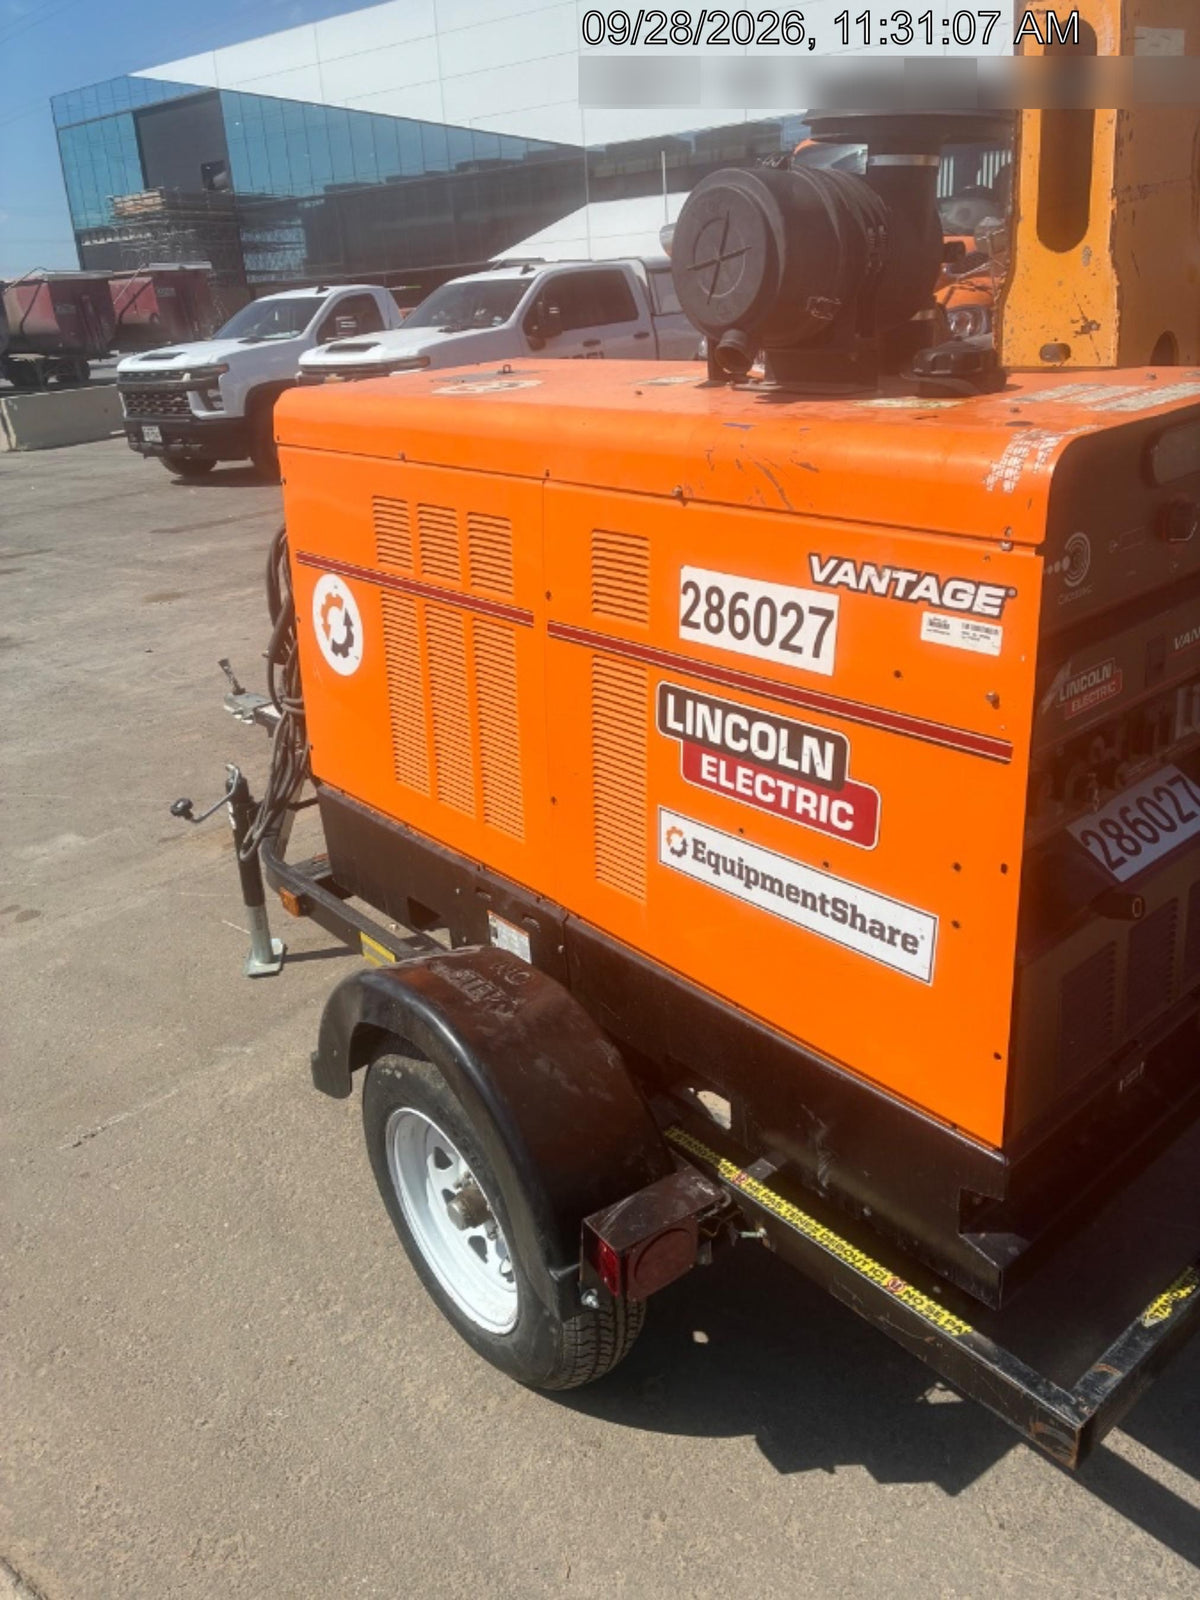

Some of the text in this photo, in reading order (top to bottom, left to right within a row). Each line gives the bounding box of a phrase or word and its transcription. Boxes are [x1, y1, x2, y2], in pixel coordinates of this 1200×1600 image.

[681, 580, 835, 659] 286027
[809, 552, 1007, 618] VANTAGE
[1059, 662, 1112, 702] LINCOLN
[666, 693, 835, 782] LINCOLN
[701, 753, 854, 831] ELECTRIC
[1081, 774, 1200, 871] 286027
[690, 837, 920, 956] EquipmentShare
[902, 1288, 924, 1306] NO
